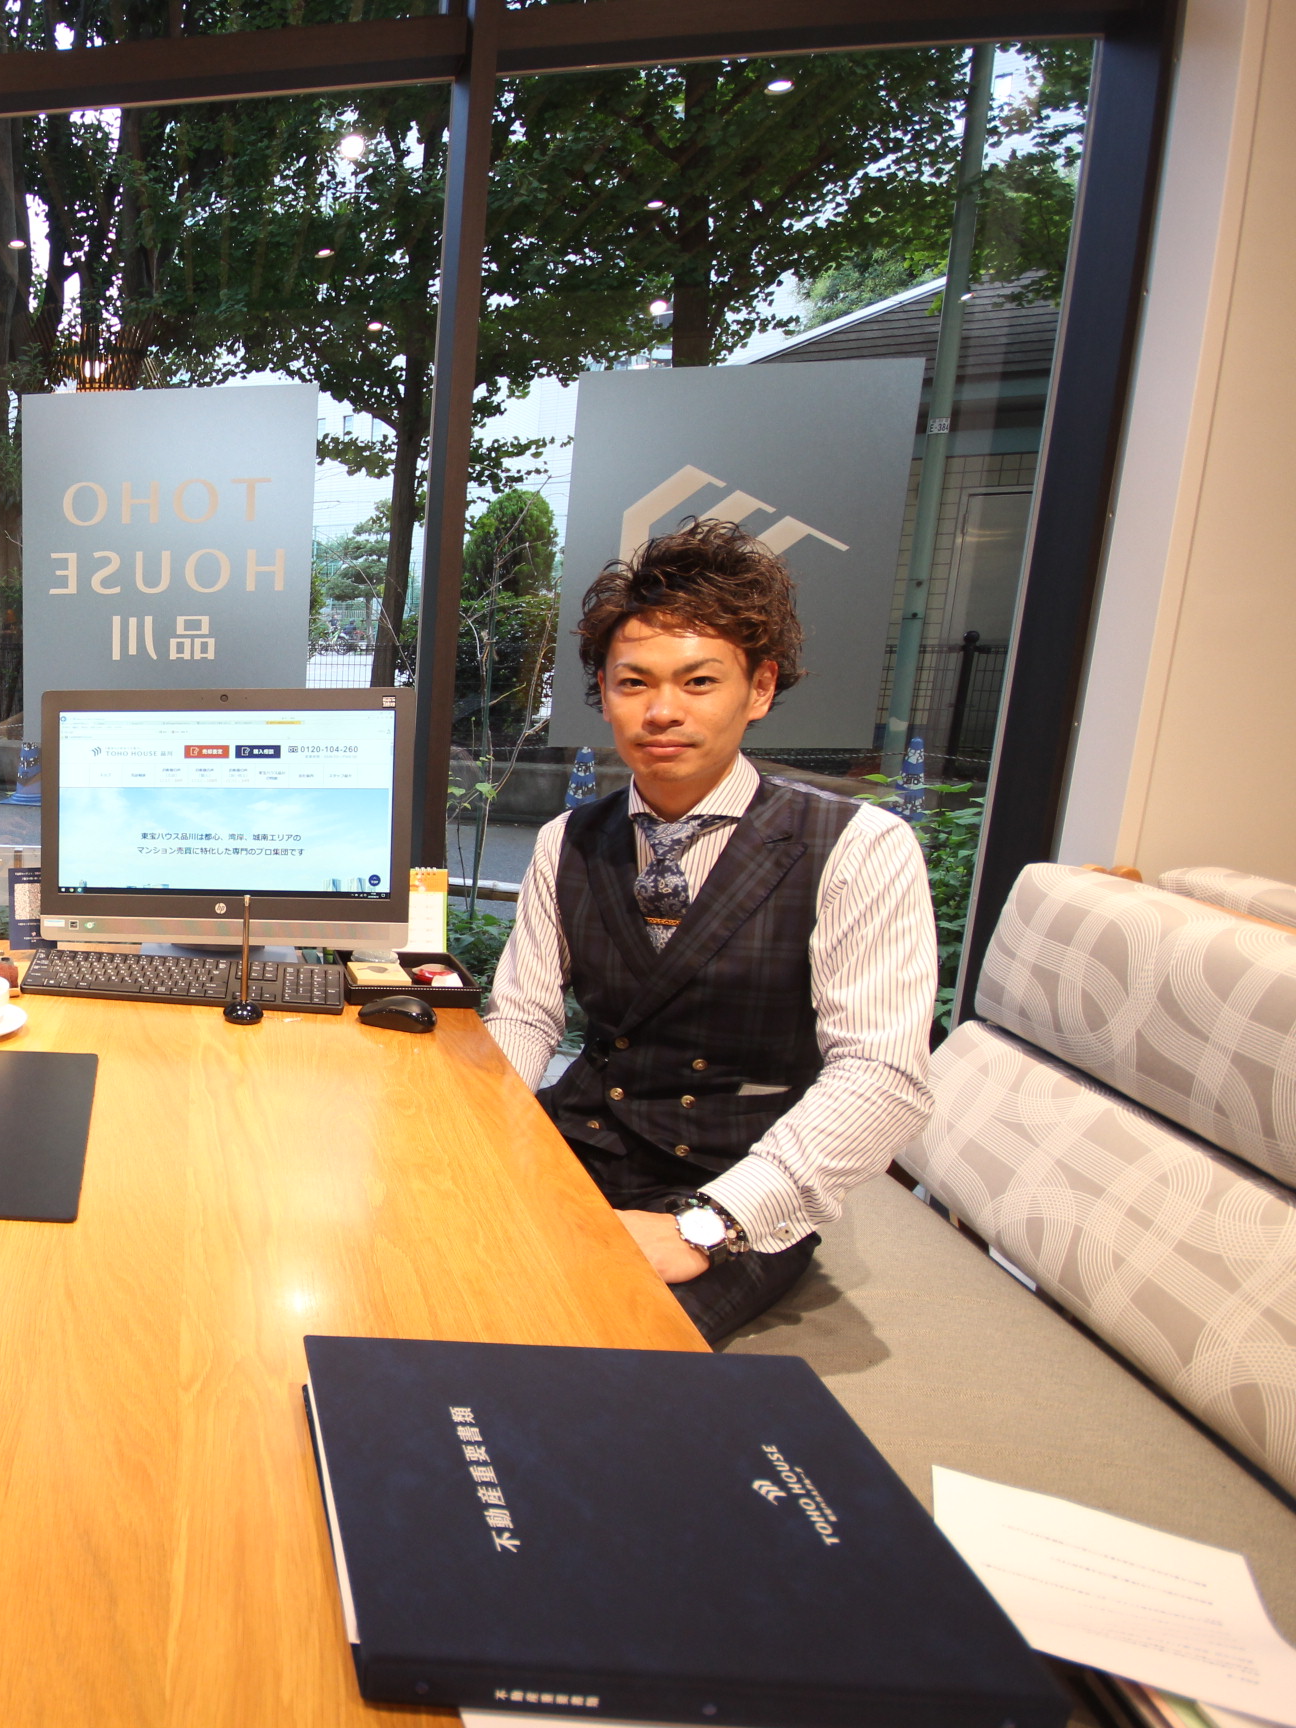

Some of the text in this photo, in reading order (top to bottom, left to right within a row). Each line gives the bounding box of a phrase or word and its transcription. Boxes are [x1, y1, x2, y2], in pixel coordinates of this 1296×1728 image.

[300, 745, 359, 753] 0120-104-260
[449, 1406, 521, 1553] 不動産重要書類
[761, 1444, 841, 1546] TOHO HOUSE
